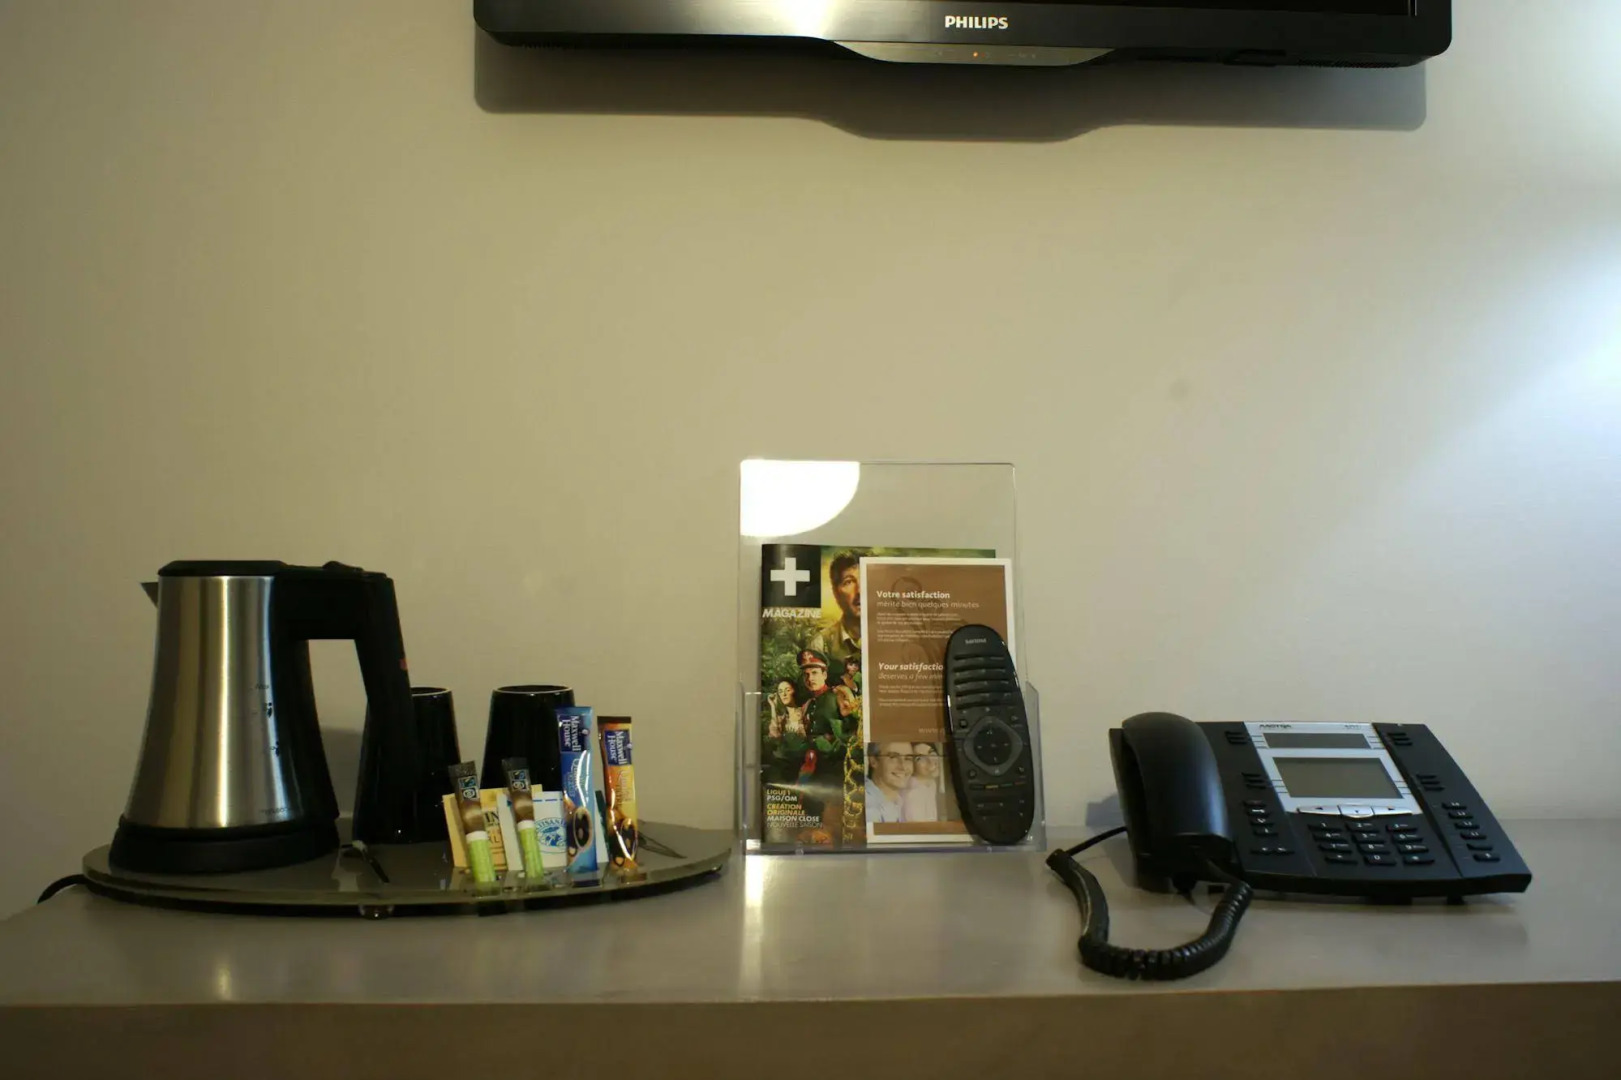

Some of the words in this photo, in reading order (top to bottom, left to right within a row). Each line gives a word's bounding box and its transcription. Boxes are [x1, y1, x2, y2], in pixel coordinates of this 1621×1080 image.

[944, 15, 1009, 30] PHILIPS
[876, 590, 900, 599] Votre
[901, 590, 951, 599] satisfaction
[762, 608, 822, 619] MAGAZINE
[918, 602, 949, 610] quelques
[878, 662, 899, 671] Your
[900, 662, 944, 674] satisfactio
[562, 719, 571, 748] House
[570, 715, 581, 751] Maxwell
[607, 735, 617, 762] House
[616, 731, 627, 765] Maxwell
